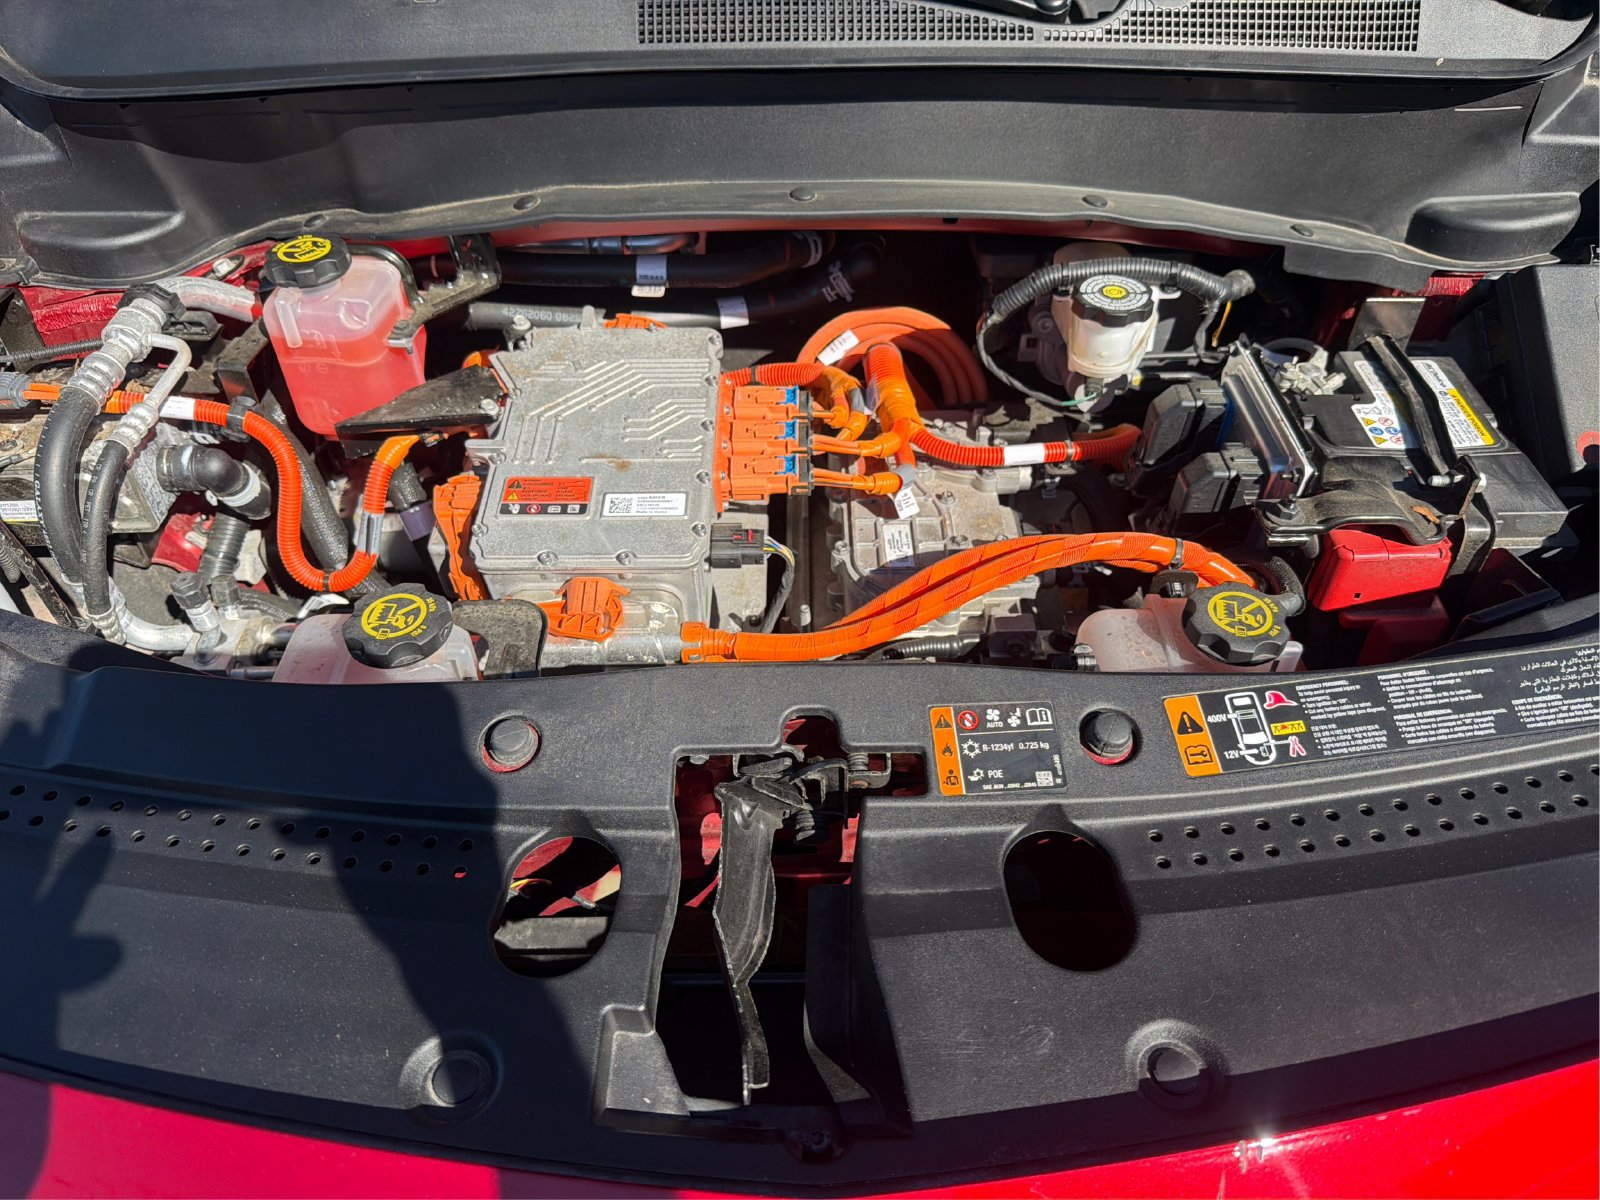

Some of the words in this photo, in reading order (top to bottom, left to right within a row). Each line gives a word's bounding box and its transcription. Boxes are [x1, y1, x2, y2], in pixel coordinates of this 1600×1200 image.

[1207, 714, 1227, 723] 400V
[982, 743, 1014, 752] R-1234yf
[1040, 741, 1050, 750] kg
[1224, 750, 1239, 759] 12V
[988, 770, 1003, 778] POE
